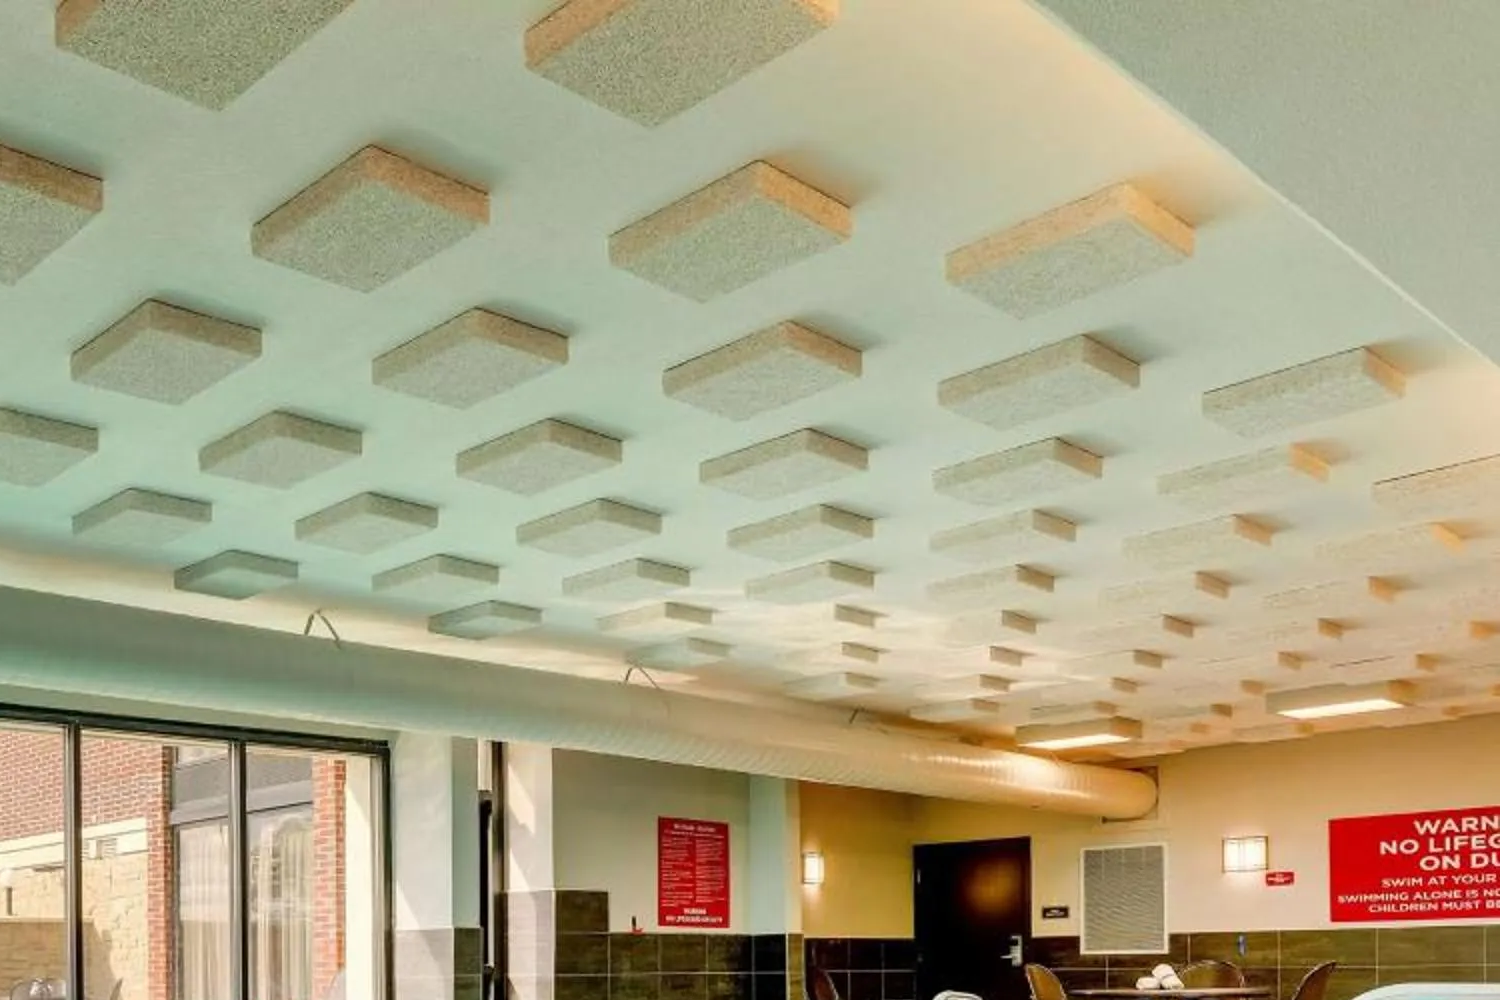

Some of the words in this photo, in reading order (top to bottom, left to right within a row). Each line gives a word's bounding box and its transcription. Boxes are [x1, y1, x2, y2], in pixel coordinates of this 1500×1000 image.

[1379, 839, 1420, 856] NO
[1419, 853, 1461, 871] ON
[1381, 877, 1423, 888] SWIM
[1427, 875, 1447, 886] AT
[1451, 873, 1497, 885] YOUR
[1337, 891, 1409, 904] SWIMMING
[1413, 889, 1462, 901] ALONE
[1465, 888, 1479, 899] IS
[1368, 901, 1438, 914] CHILDREN
[1442, 900, 1480, 911] MUST
